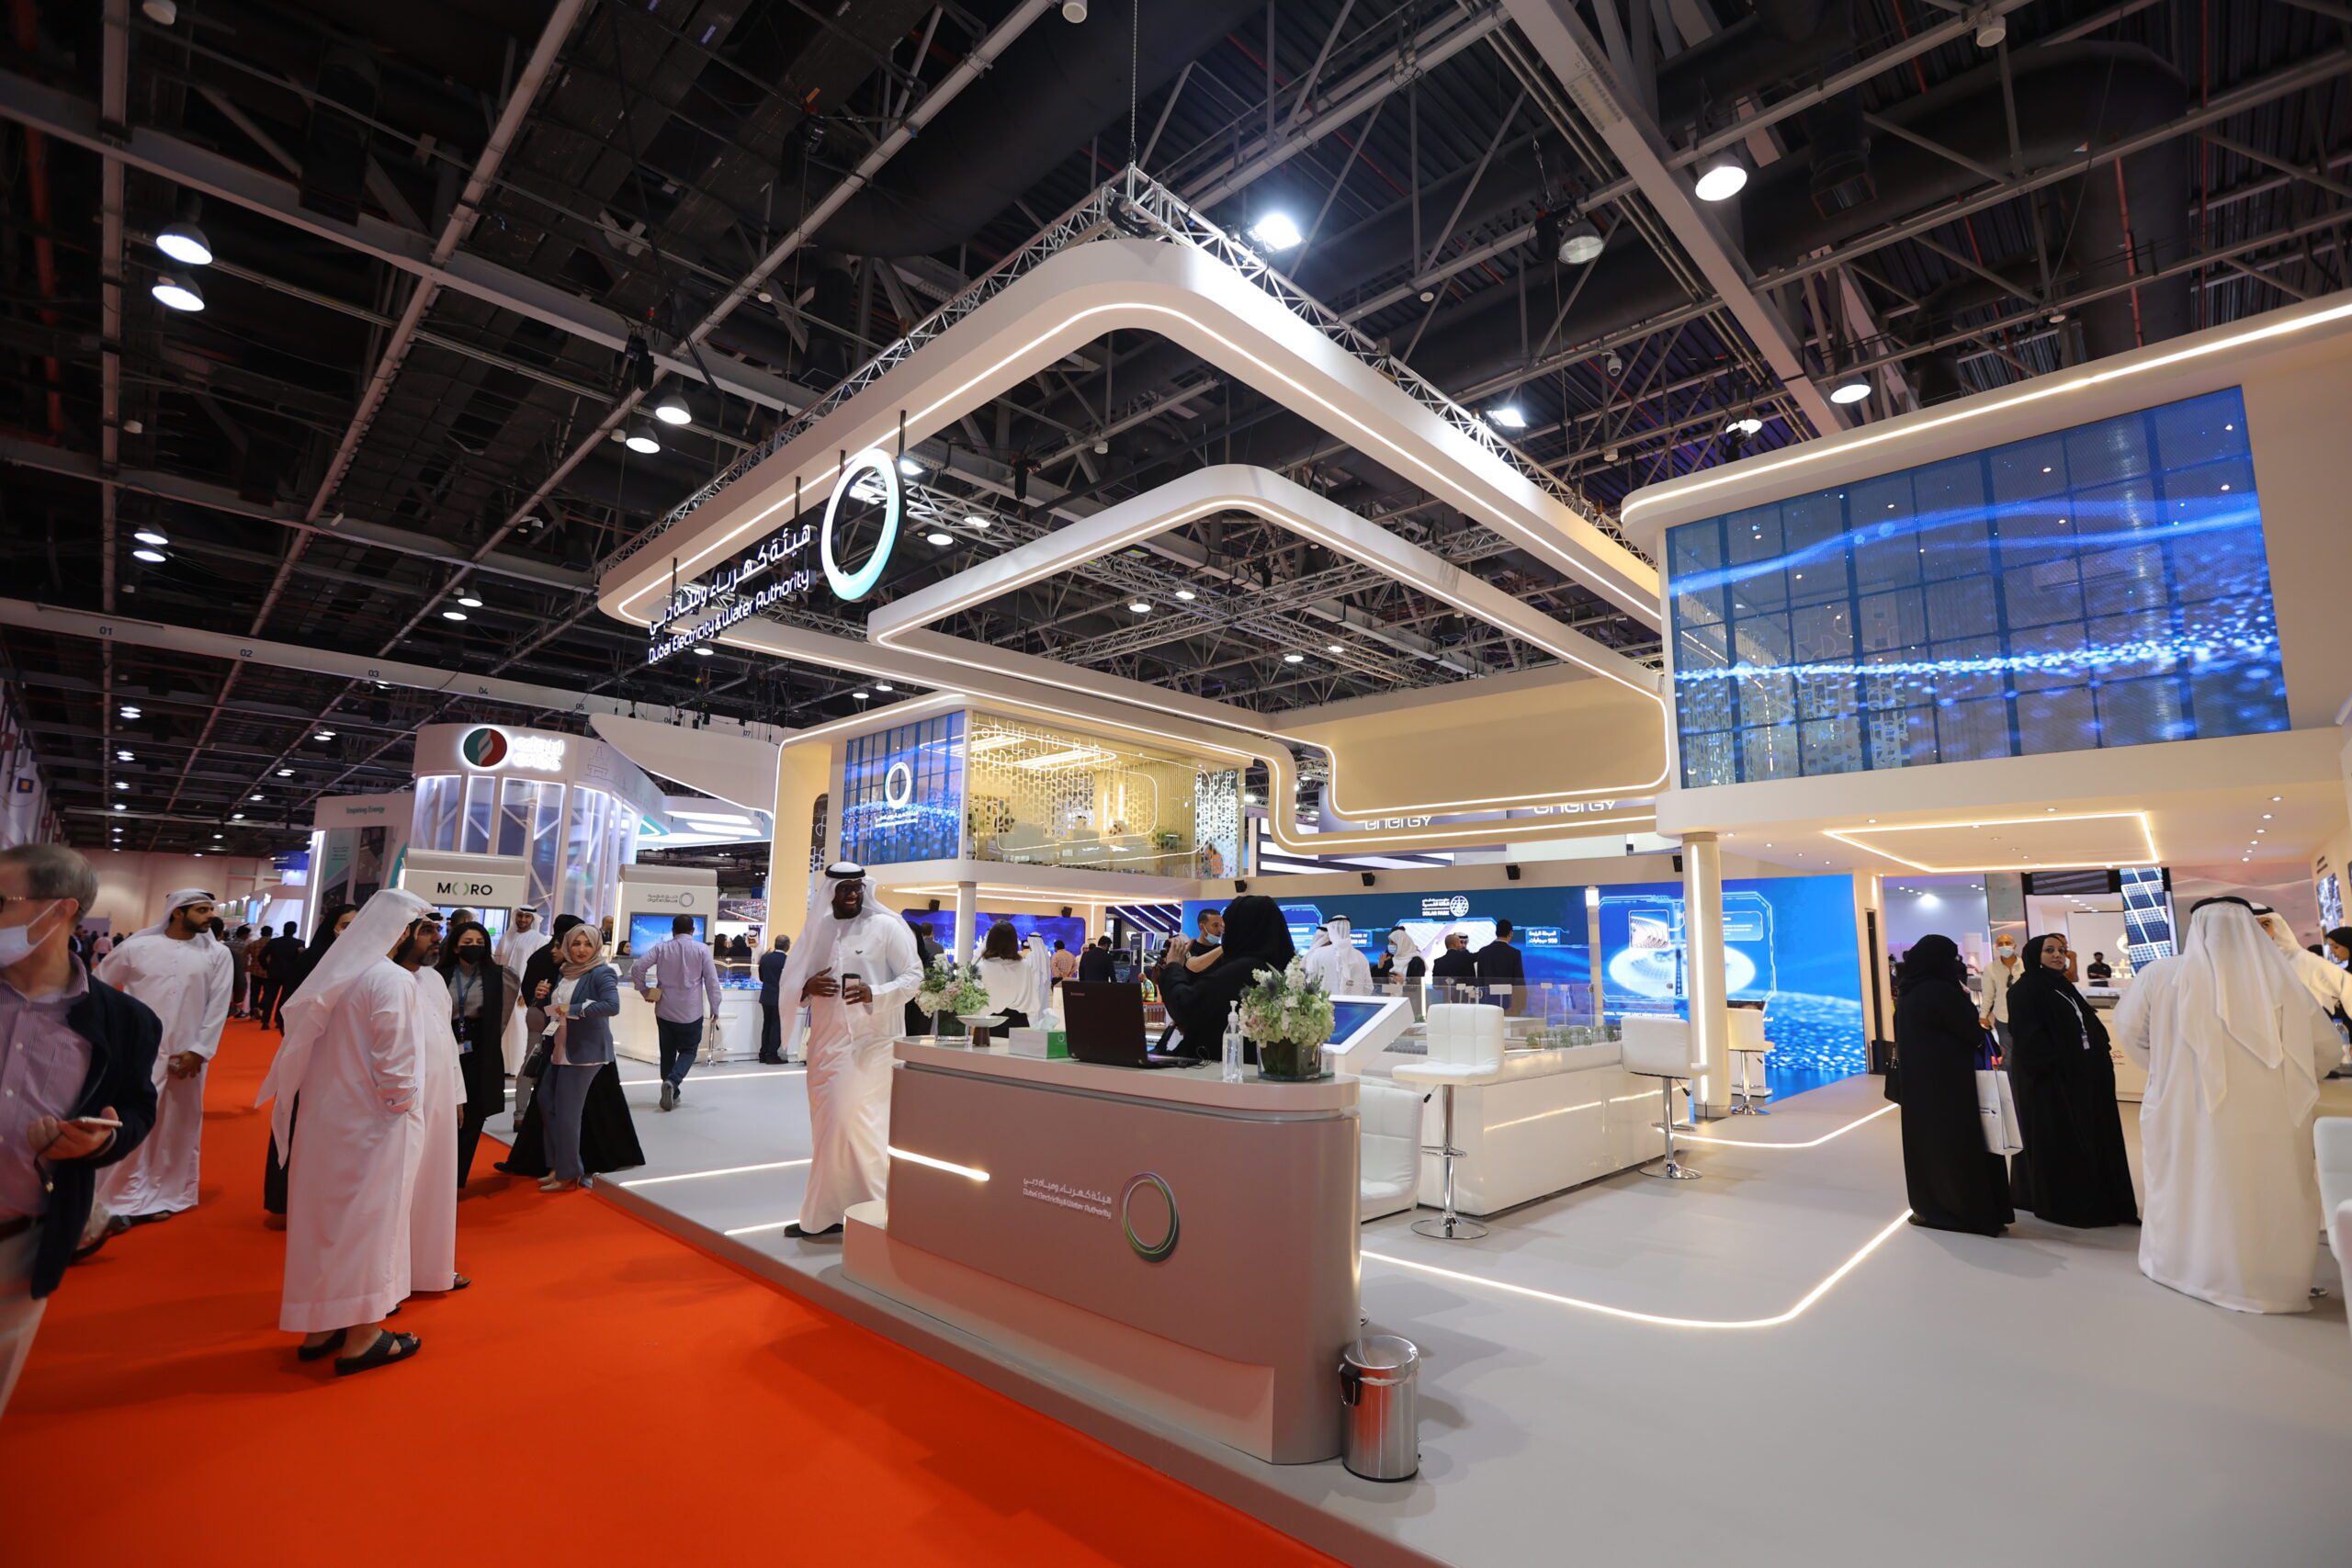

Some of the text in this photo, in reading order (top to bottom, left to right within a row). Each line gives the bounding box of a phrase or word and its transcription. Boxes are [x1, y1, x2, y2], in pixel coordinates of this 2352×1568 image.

[650, 524, 810, 641] هيئة كهرباء ومياه دبي
[649, 637, 672, 664] Dubai
[673, 620, 714, 653] Electricity
[722, 599, 755, 626] Water
[755, 569, 809, 611] Authority
[99, 626, 112, 636] 01
[240, 649, 253, 658] 02
[368, 669, 379, 678] 03
[479, 686, 488, 694] 04
[368, 806, 385, 815] Energy
[1023, 1177, 1112, 1205] هيئة كهرباء ومياه دبي
[1023, 1188, 1038, 1198] Dubai
[1084, 1204, 1112, 1221] Authority
